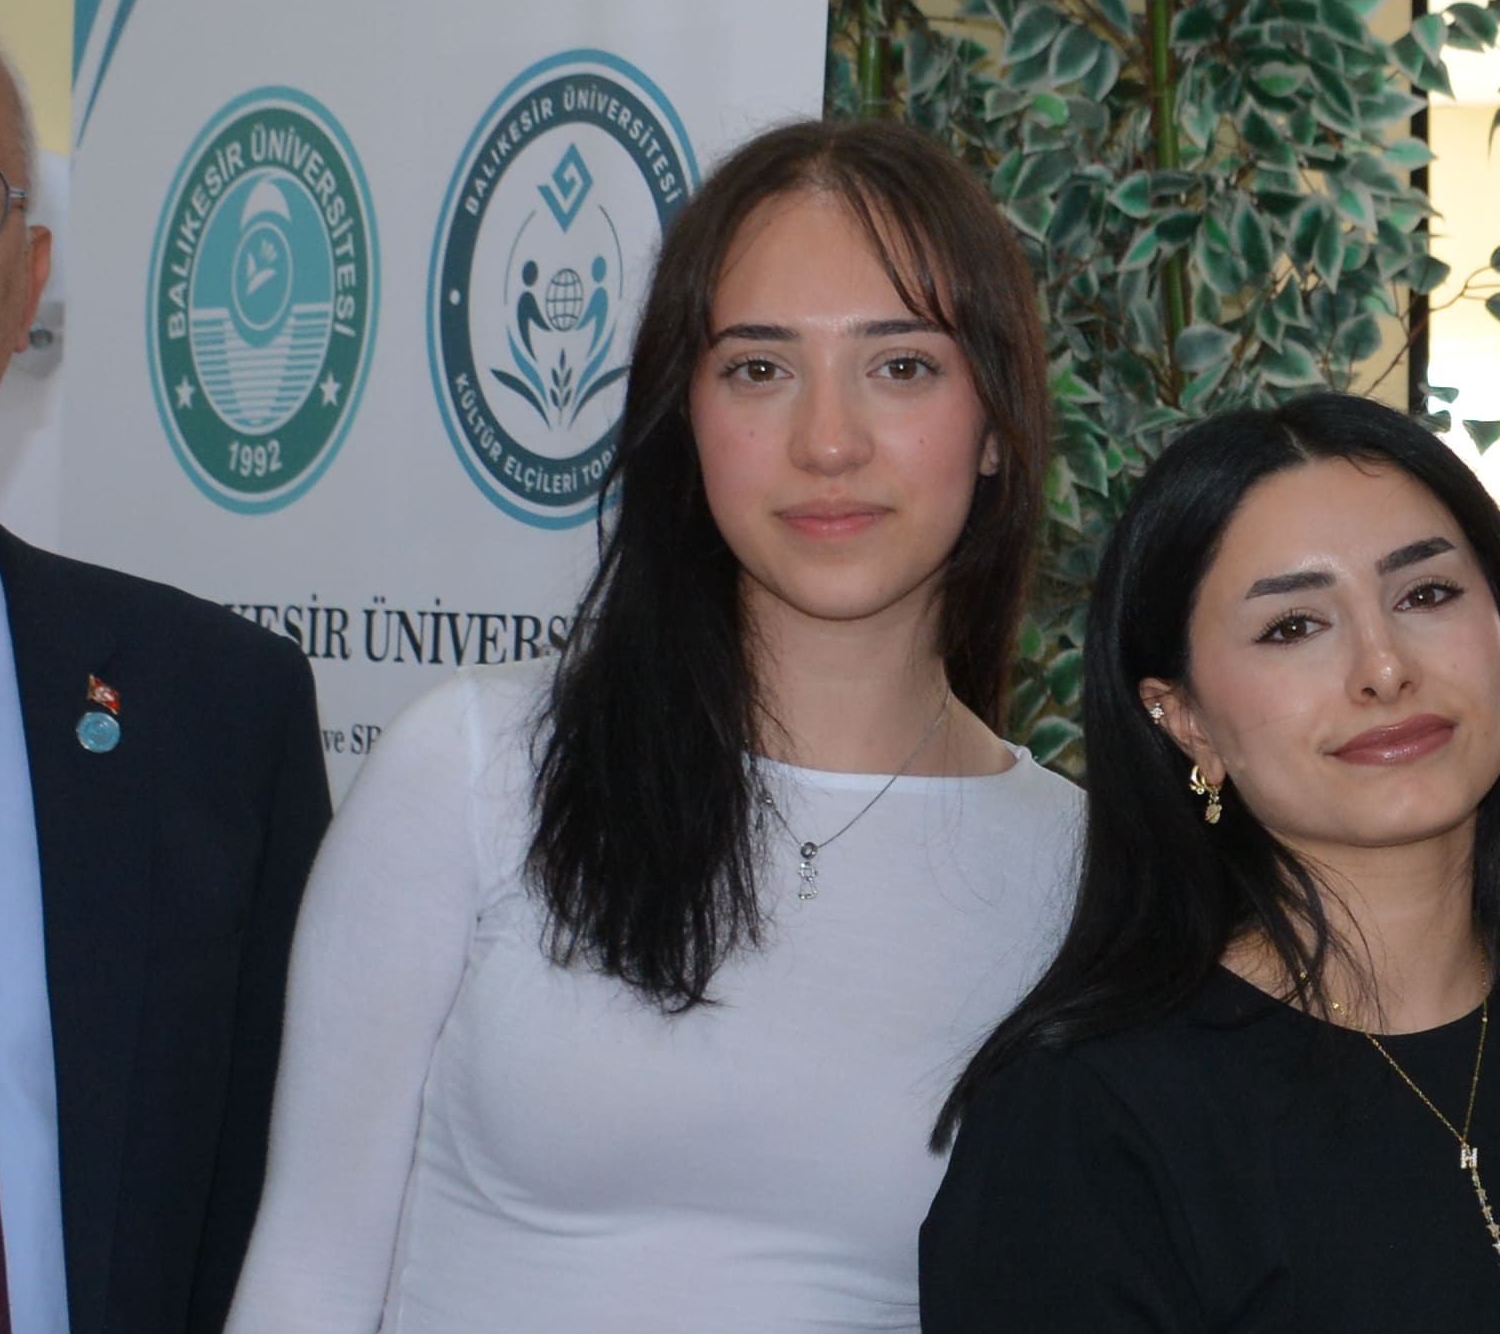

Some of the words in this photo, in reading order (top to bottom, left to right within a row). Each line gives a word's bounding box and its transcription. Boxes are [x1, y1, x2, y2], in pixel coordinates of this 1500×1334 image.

[465, 98, 554, 217] BALIKESİR
[563, 85, 683, 204] ÜNİVERSİTESİ
[168, 140, 245, 339] BALIKESİR
[251, 123, 356, 337] ÜNİVERSİTESİ
[229, 440, 282, 476] 1992
[455, 373, 503, 463] KÜLTÜR
[504, 455, 578, 494] ELÇİLERİ
[363, 596, 585, 667] ÜNİVERS
